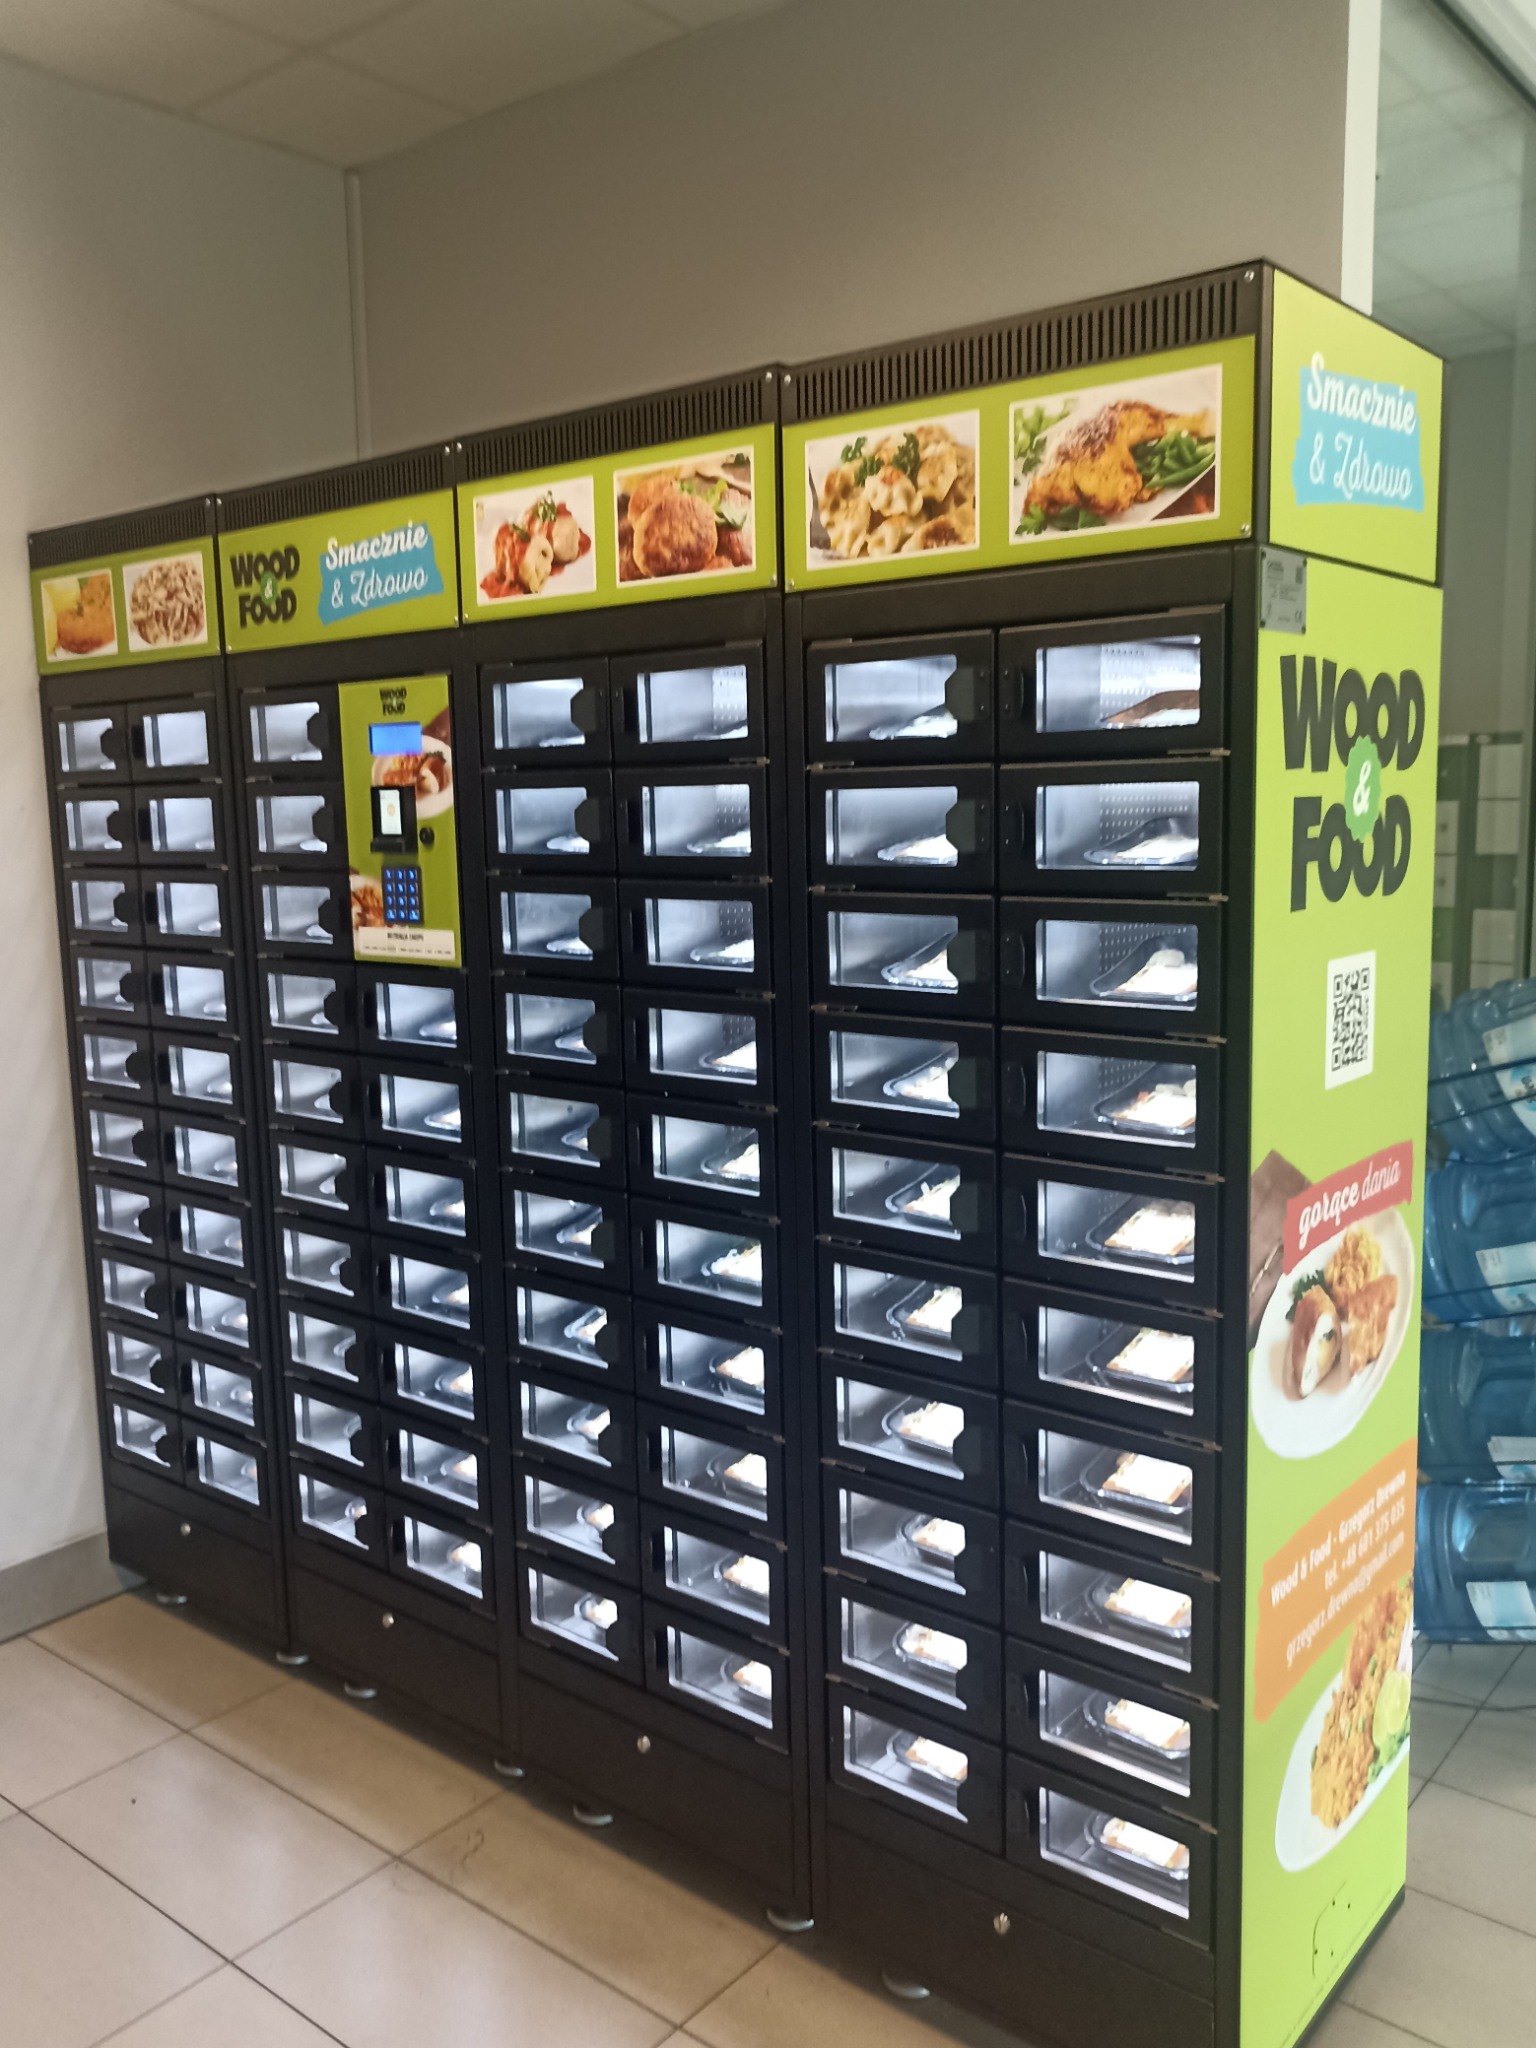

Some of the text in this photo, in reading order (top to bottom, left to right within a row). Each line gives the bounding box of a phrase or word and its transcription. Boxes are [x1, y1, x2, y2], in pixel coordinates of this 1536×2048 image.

[1306, 351, 1416, 436] Smacznie
[1309, 431, 1412, 500] & Zdrowo
[230, 545, 300, 590] WOOD
[325, 519, 429, 571] Smacznie
[239, 588, 297, 630] FOOD
[264, 577, 273, 600] &
[331, 566, 428, 609] & Zdrowo
[1280, 654, 1425, 772] WOOD
[1353, 760, 1372, 817] &
[1290, 794, 1412, 912] FOOD
[1298, 1157, 1401, 1250] gorące dania
[1271, 1561, 1298, 1607] Wood
[1300, 1557, 1308, 1581] &
[1309, 1530, 1331, 1572] Food
